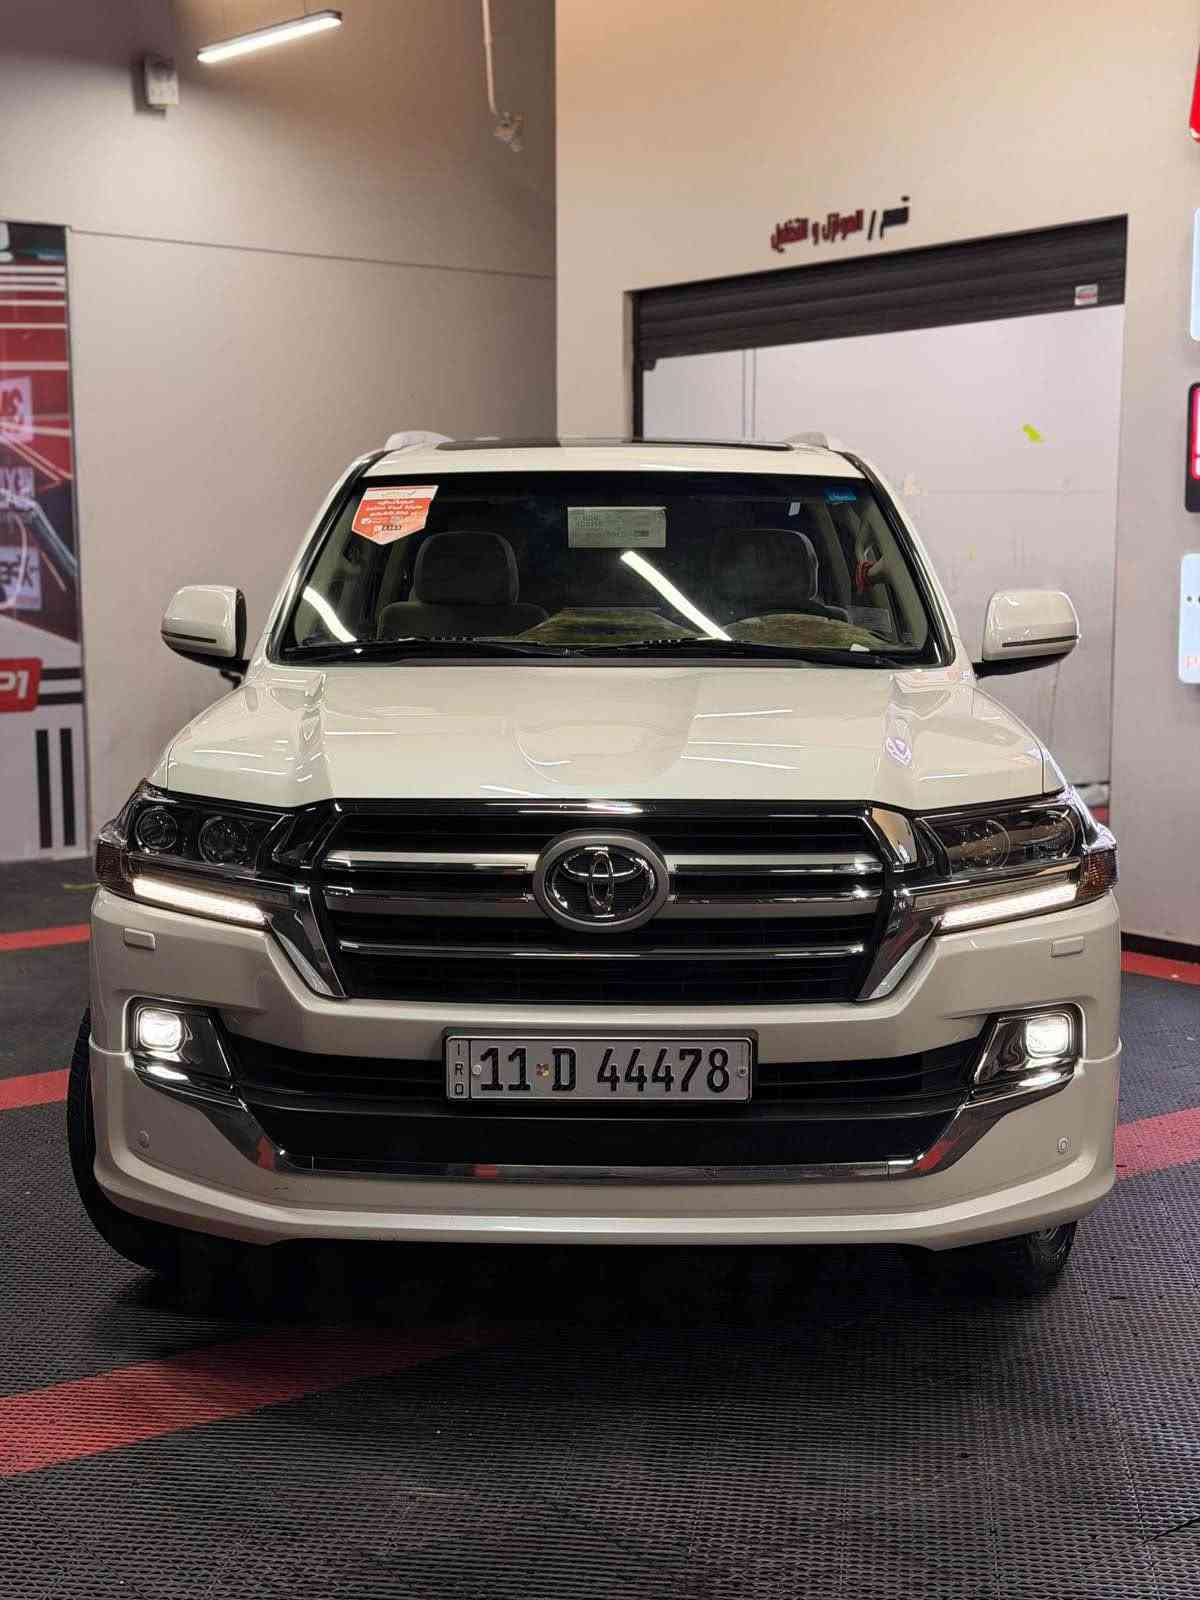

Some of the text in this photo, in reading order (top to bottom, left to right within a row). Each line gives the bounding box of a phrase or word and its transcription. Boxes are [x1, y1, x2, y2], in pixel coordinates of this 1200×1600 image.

[480, 1047, 730, 1093] 11 D 44478
